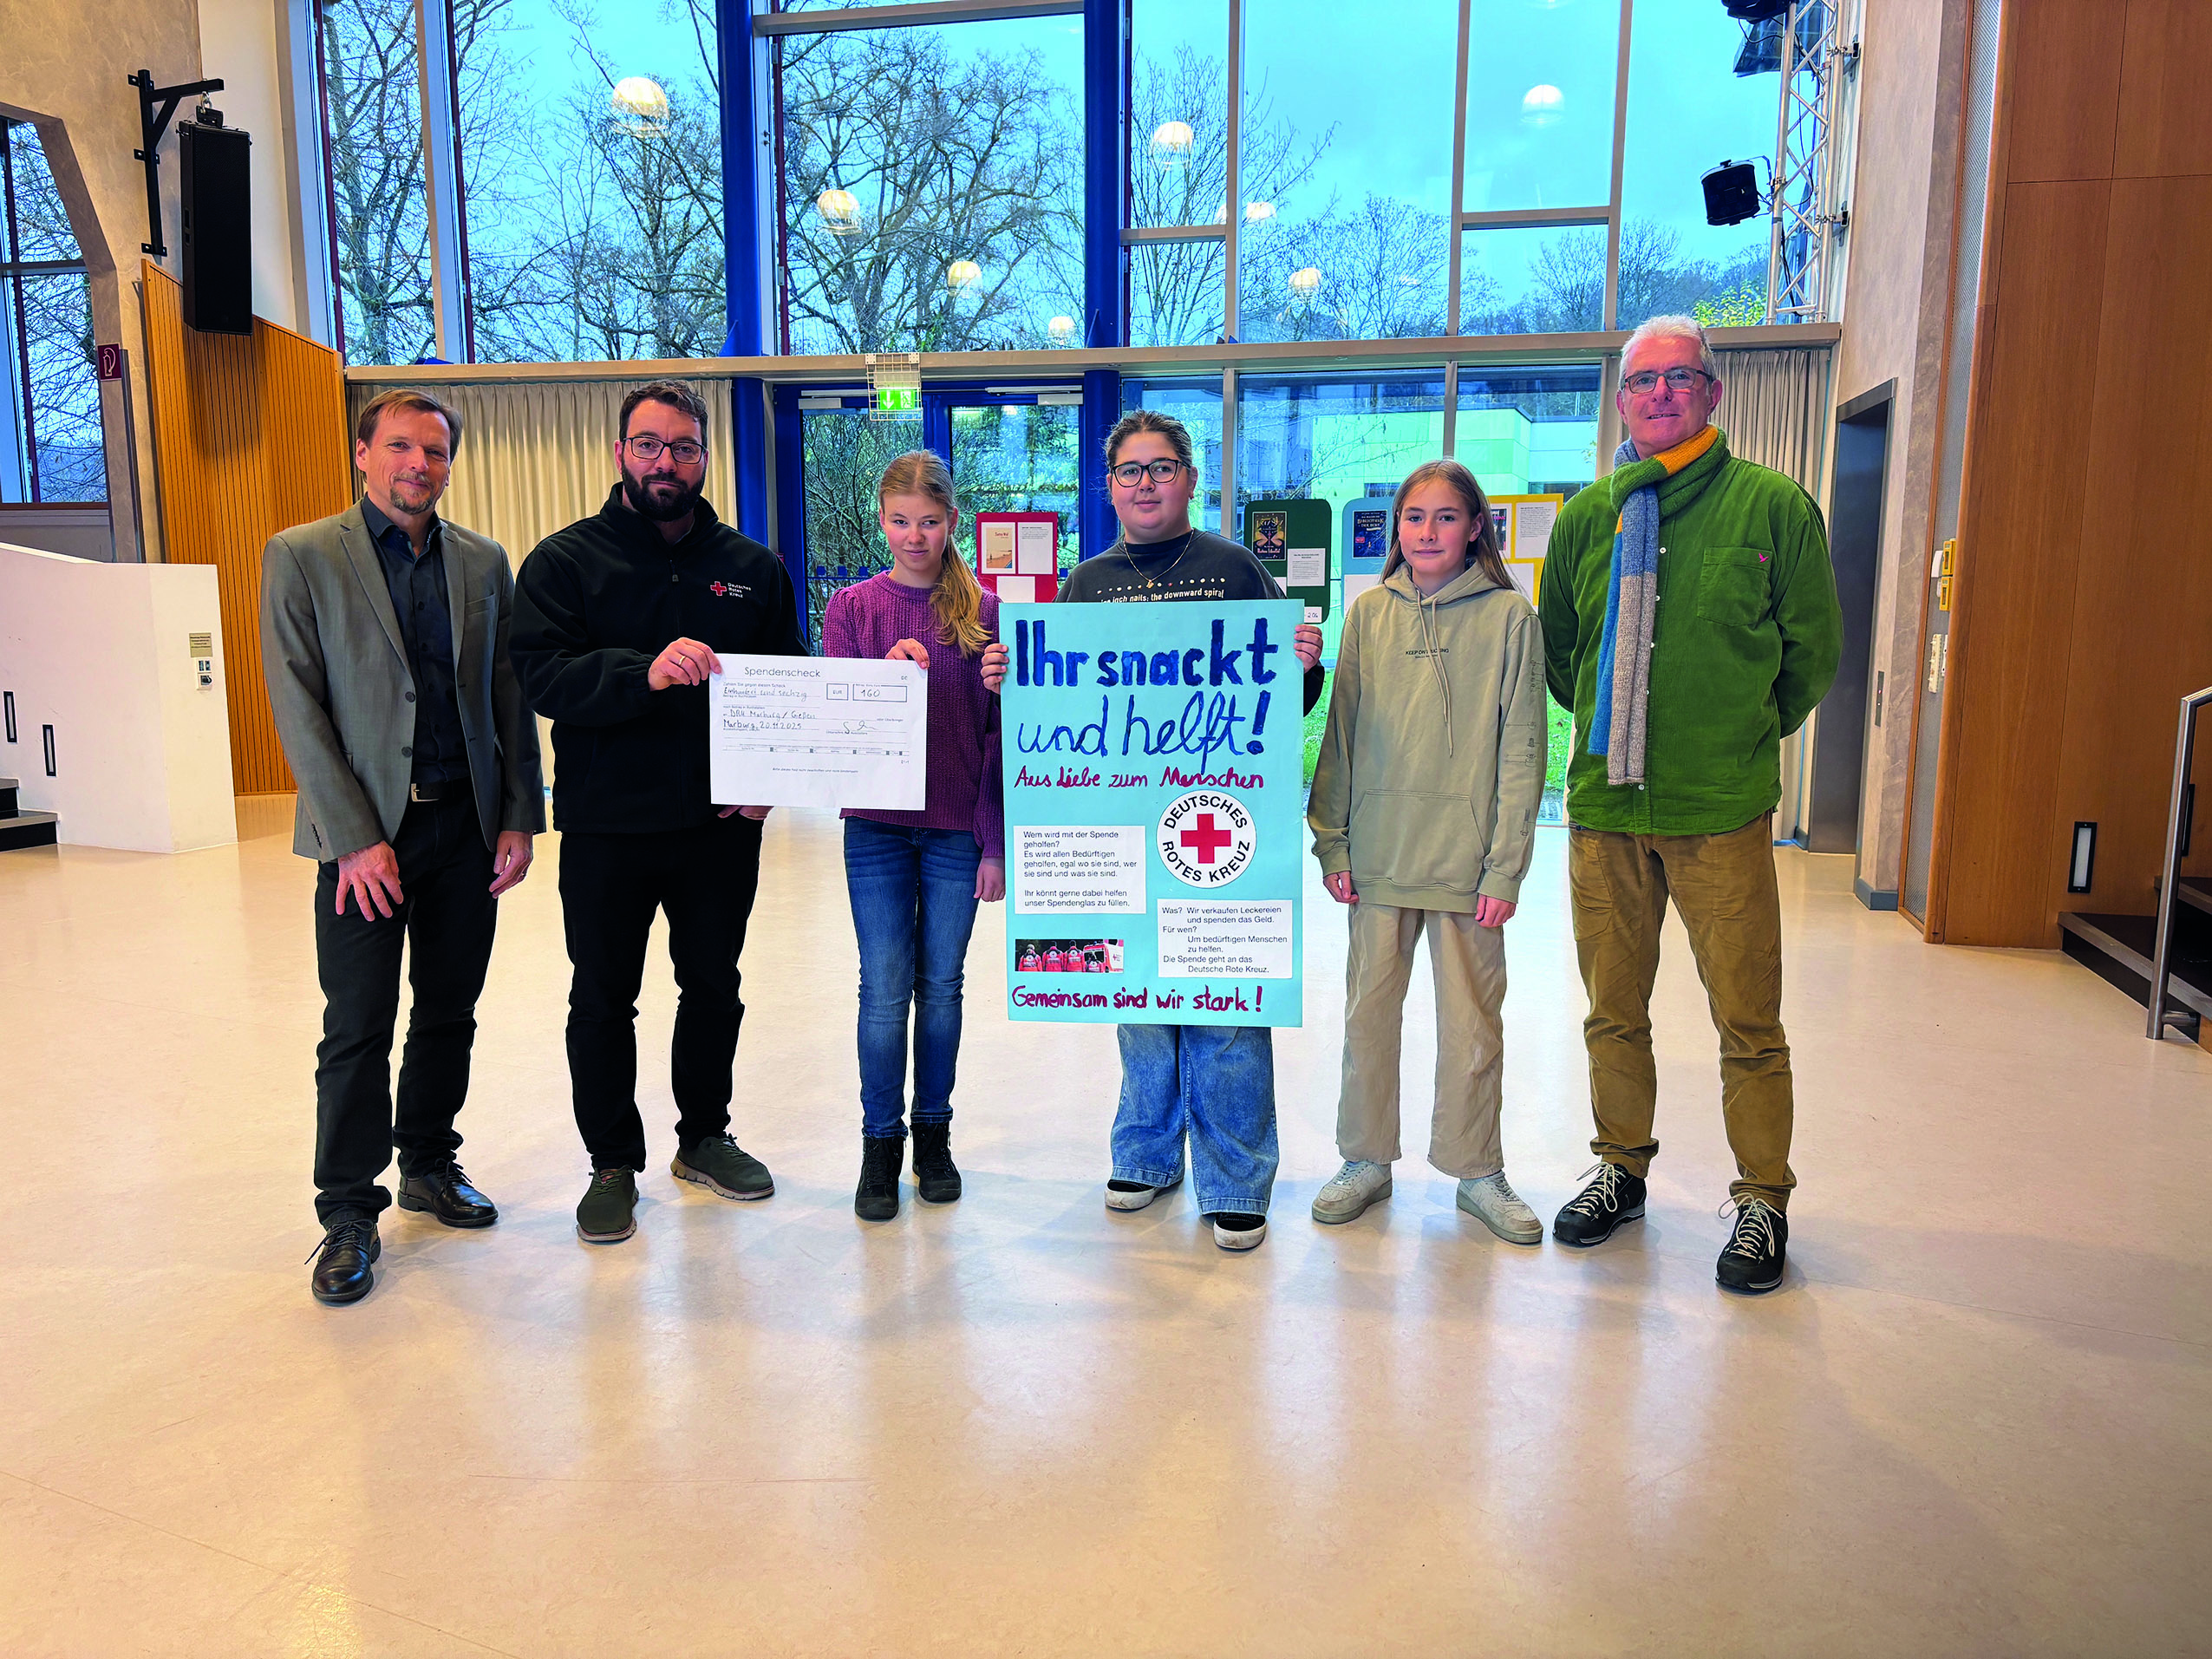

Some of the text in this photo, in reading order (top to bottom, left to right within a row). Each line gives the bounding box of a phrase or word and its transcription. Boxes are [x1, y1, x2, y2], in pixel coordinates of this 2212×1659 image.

[1130, 594, 1149, 603] nails:
[1164, 588, 1203, 598] downward
[1204, 588, 1224, 598] spiral
[1015, 617, 1279, 688] Ihr snackt
[744, 666, 821, 677] Spendenscheck
[861, 689, 880, 697] 160
[1018, 690, 1272, 775] und helft!
[1015, 765, 1265, 789] Aus Liebe zum Menschen
[1163, 794, 1248, 829] DEUTSCHES
[1090, 831, 1119, 839] Spende
[1024, 840, 1060, 849] geholfen?
[1024, 860, 1058, 869] geholfen,
[1060, 860, 1076, 869] egal
[1162, 840, 1250, 883] ROTES KREUZ
[1047, 899, 1096, 908] Spendenglas
[1204, 916, 1237, 924] spenden
[1204, 936, 1246, 944] bedürftigen
[1178, 956, 1207, 964] Spende
[1209, 956, 1226, 964] geht
[1011, 984, 1108, 1009] Gemeinsam
[1113, 986, 1147, 1009] sind
[1156, 989, 1184, 1009] wir
